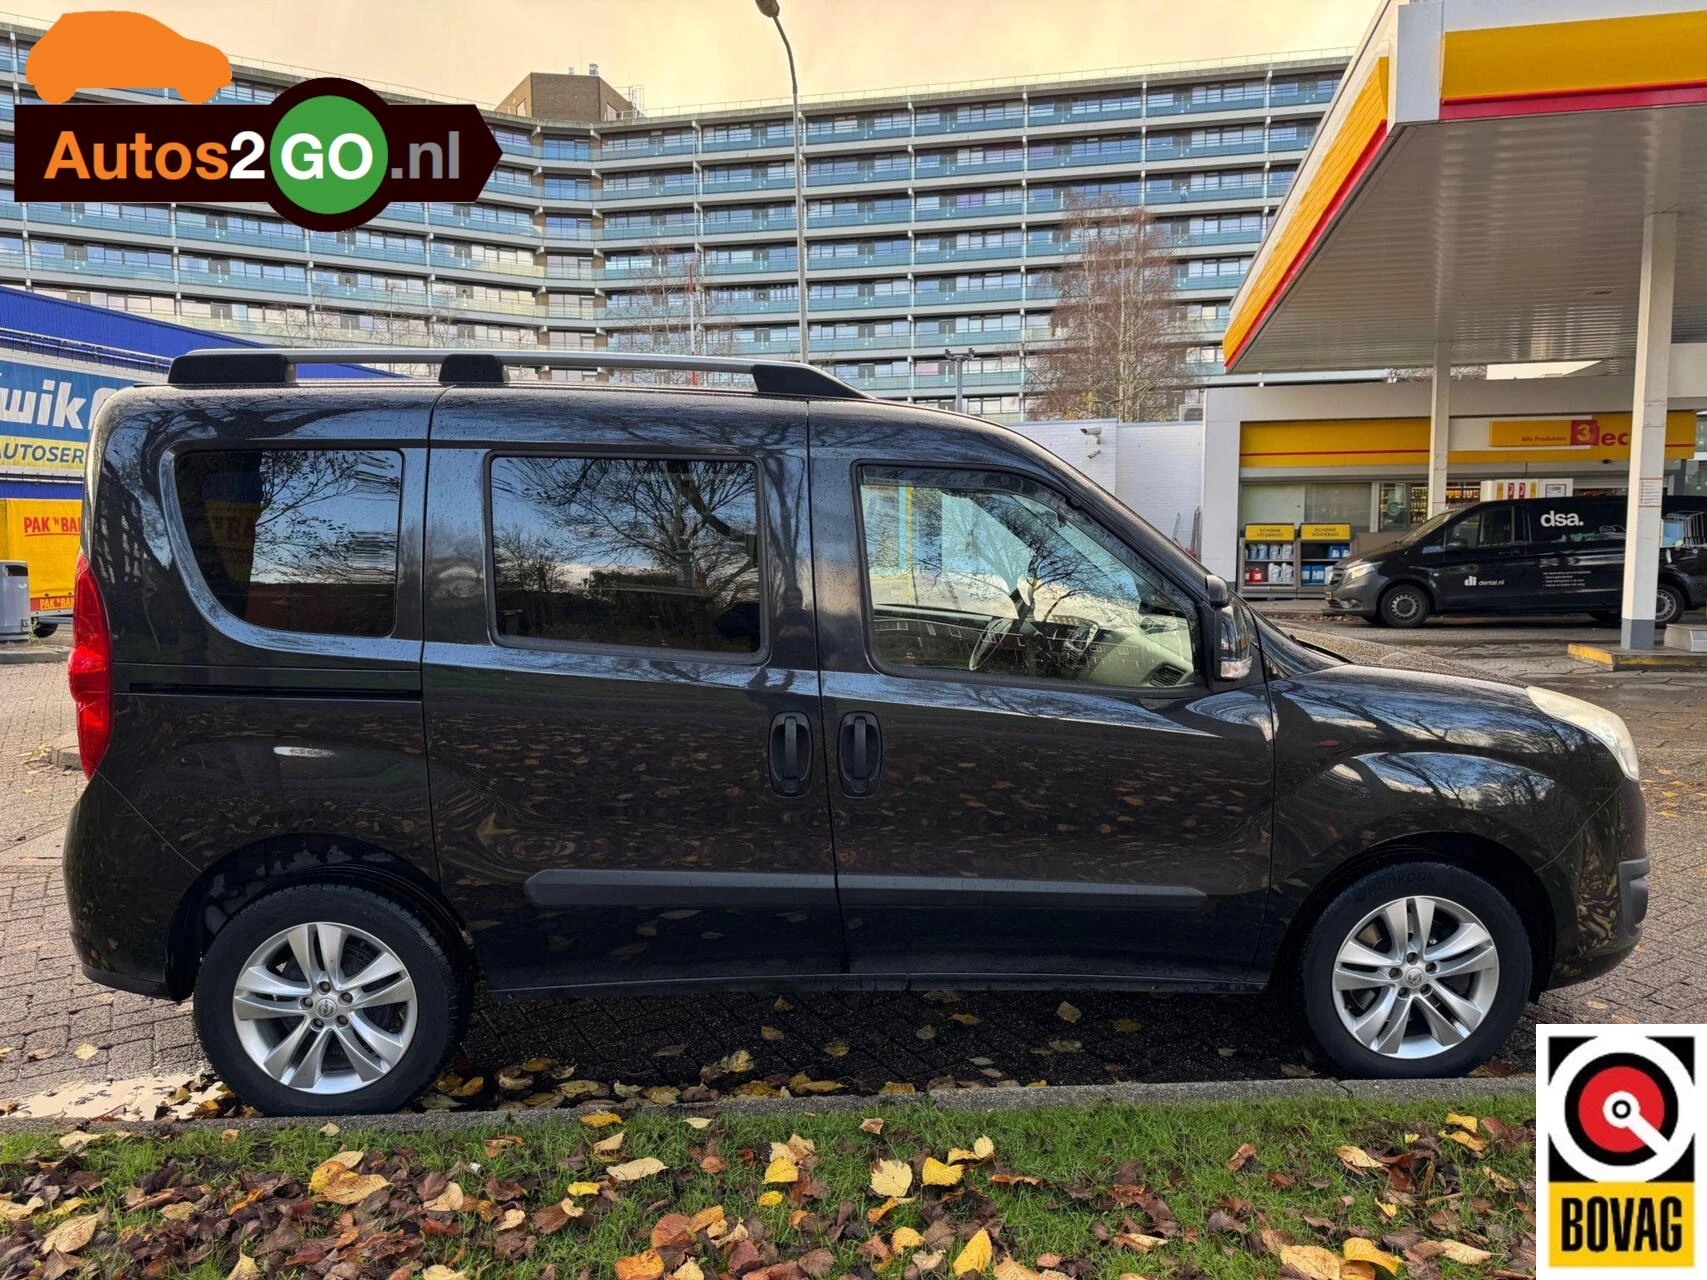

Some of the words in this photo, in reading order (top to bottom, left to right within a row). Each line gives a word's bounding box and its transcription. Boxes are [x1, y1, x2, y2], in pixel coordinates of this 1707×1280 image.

[0, 378, 87, 430] wik
[0, 442, 85, 464] UTOSER
[24, 516, 50, 533] PAK
[1540, 510, 1584, 527] dsa.
